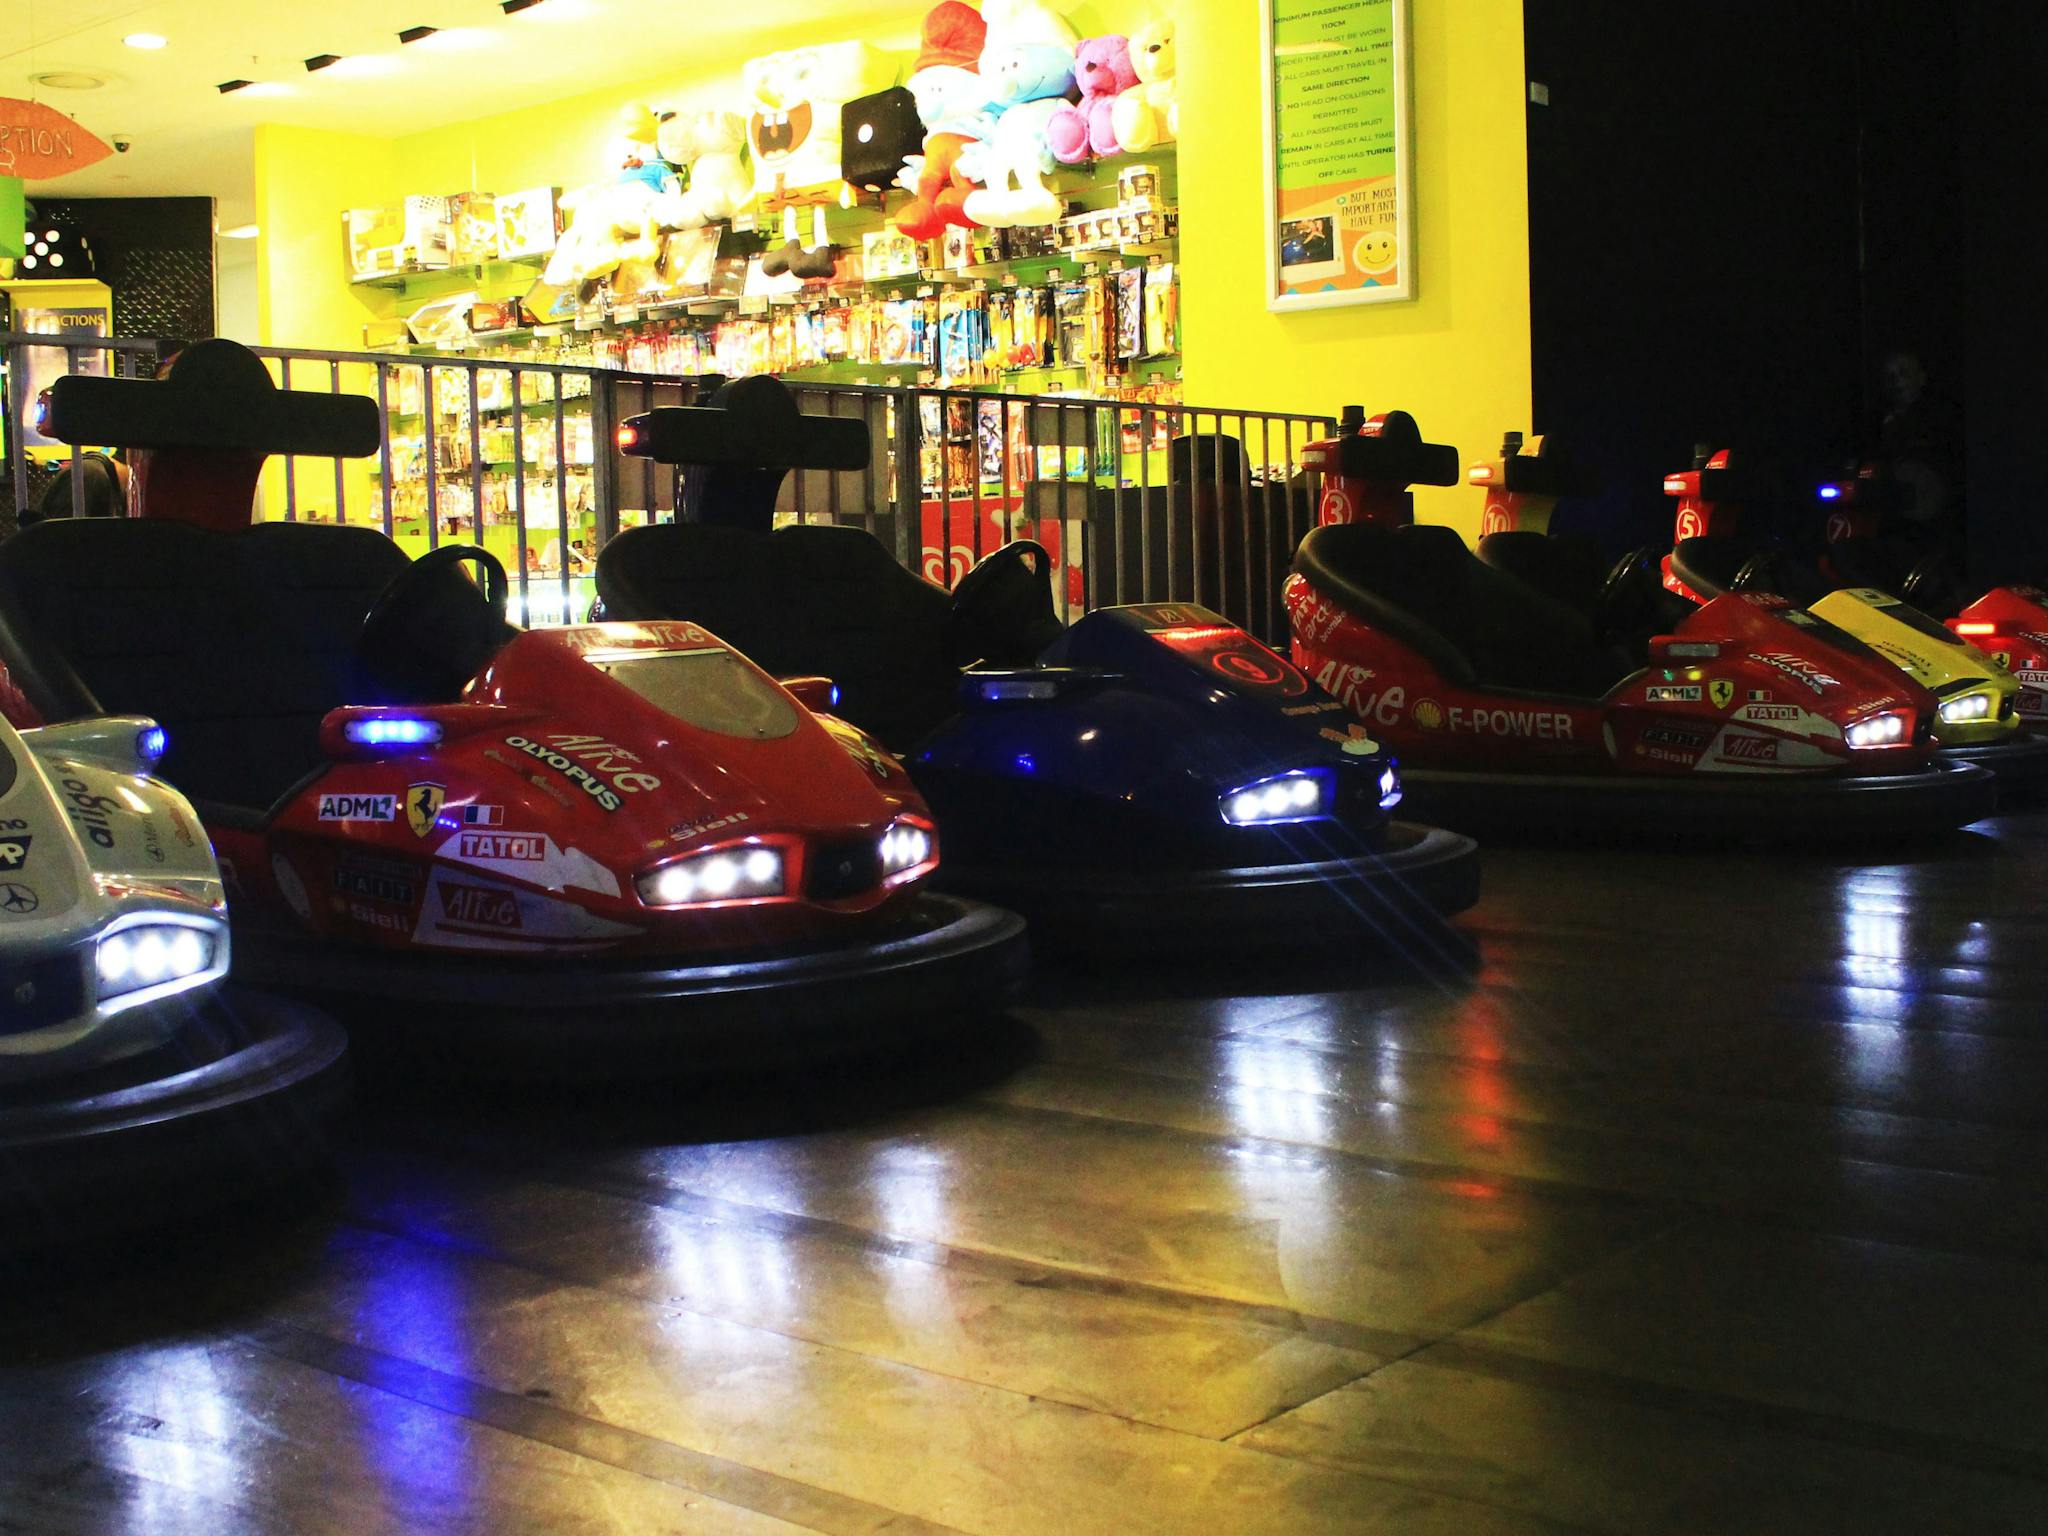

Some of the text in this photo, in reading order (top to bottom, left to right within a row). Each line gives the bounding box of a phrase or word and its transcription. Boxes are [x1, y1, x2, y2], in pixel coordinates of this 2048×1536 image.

[1312, 2, 1361, 16] PASSENGER
[1322, 20, 1346, 29] 110CM
[1359, 28, 1387, 38] WORN
[1354, 45, 1369, 54] ALL
[1284, 72, 1298, 80] ALL
[1300, 69, 1321, 78] CARS
[1323, 64, 1344, 73] MUST
[1346, 58, 1376, 70] TRAVEL
[1302, 75, 1370, 92] SAME DIRECTION
[1287, 87, 1385, 109] NO HEAD ON COLLISIONS
[1313, 107, 1358, 119] PERMITTED
[1291, 118, 1382, 138] ALL PASSENGERS MUST
[1280, 145, 1312, 155] REMAIN
[1324, 139, 1345, 148] CARS
[1359, 134, 1372, 142] ALL
[1302, 154, 1346, 167] OPERATOR
[1348, 151, 1365, 160] HAS
[1318, 167, 1358, 179] OFF CARS
[1350, 187, 1397, 203] BUT MOST
[1351, 214, 1372, 228] HAVE
[1486, 512, 1508, 533] 10
[1681, 514, 1697, 538] 5
[1832, 518, 1845, 542] 7
[1315, 660, 1405, 726] Alive
[1748, 708, 1798, 720] TATOL
[1447, 708, 1574, 740] F-POWER
[506, 736, 621, 811] OLYOPUS
[462, 836, 545, 860] TATOL
